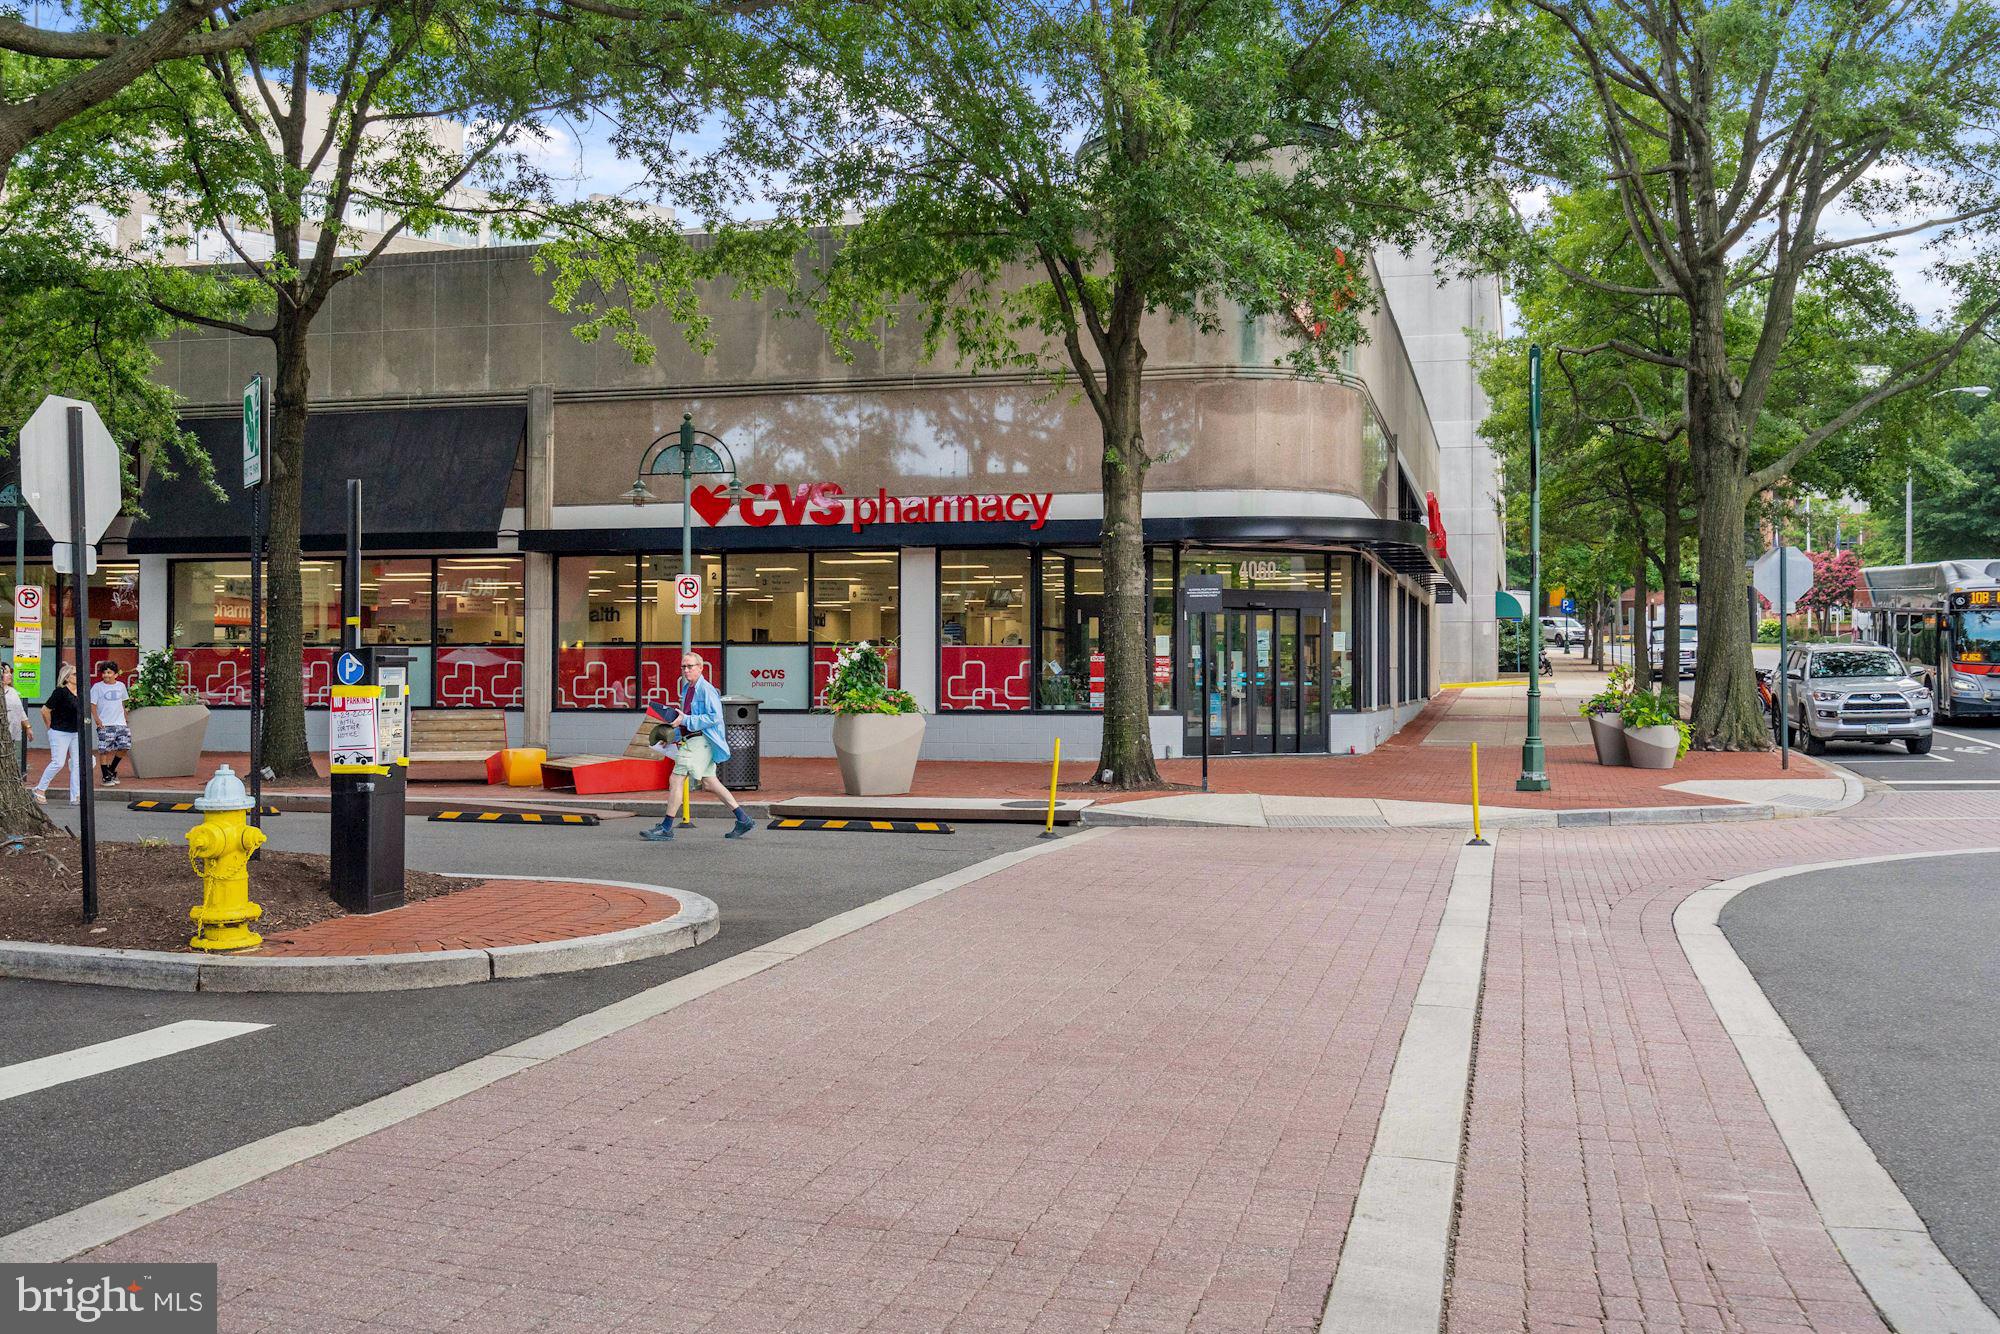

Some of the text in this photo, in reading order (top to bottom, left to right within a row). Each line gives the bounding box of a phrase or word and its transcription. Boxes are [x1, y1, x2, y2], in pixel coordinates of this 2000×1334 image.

[740, 483, 1053, 533] CVS pharmacy
[1239, 560, 1276, 580] 4060
[1970, 591, 1990, 604] 10B
[345, 659, 357, 679] P
[761, 669, 785, 679] CVS
[346, 696, 371, 705] PARKING
